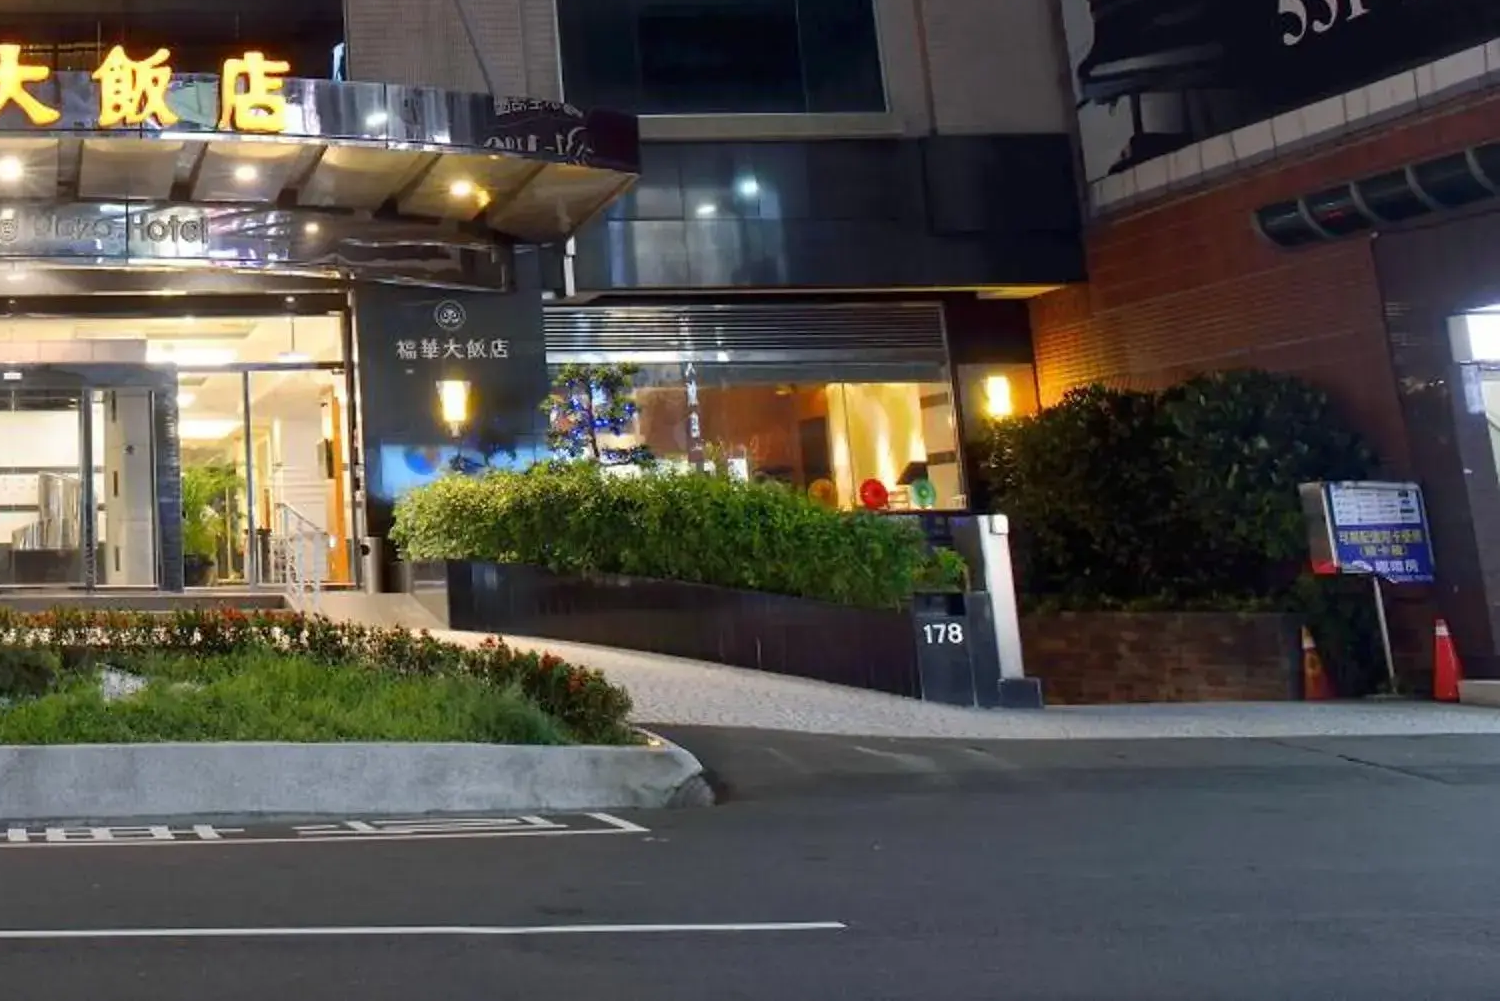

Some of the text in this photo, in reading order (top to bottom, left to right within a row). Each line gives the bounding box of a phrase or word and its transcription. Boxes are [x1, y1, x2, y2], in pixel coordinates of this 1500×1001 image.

[128, 212, 210, 245] Hotel
[396, 338, 510, 359] 福華大飯店
[923, 623, 965, 645] 178
